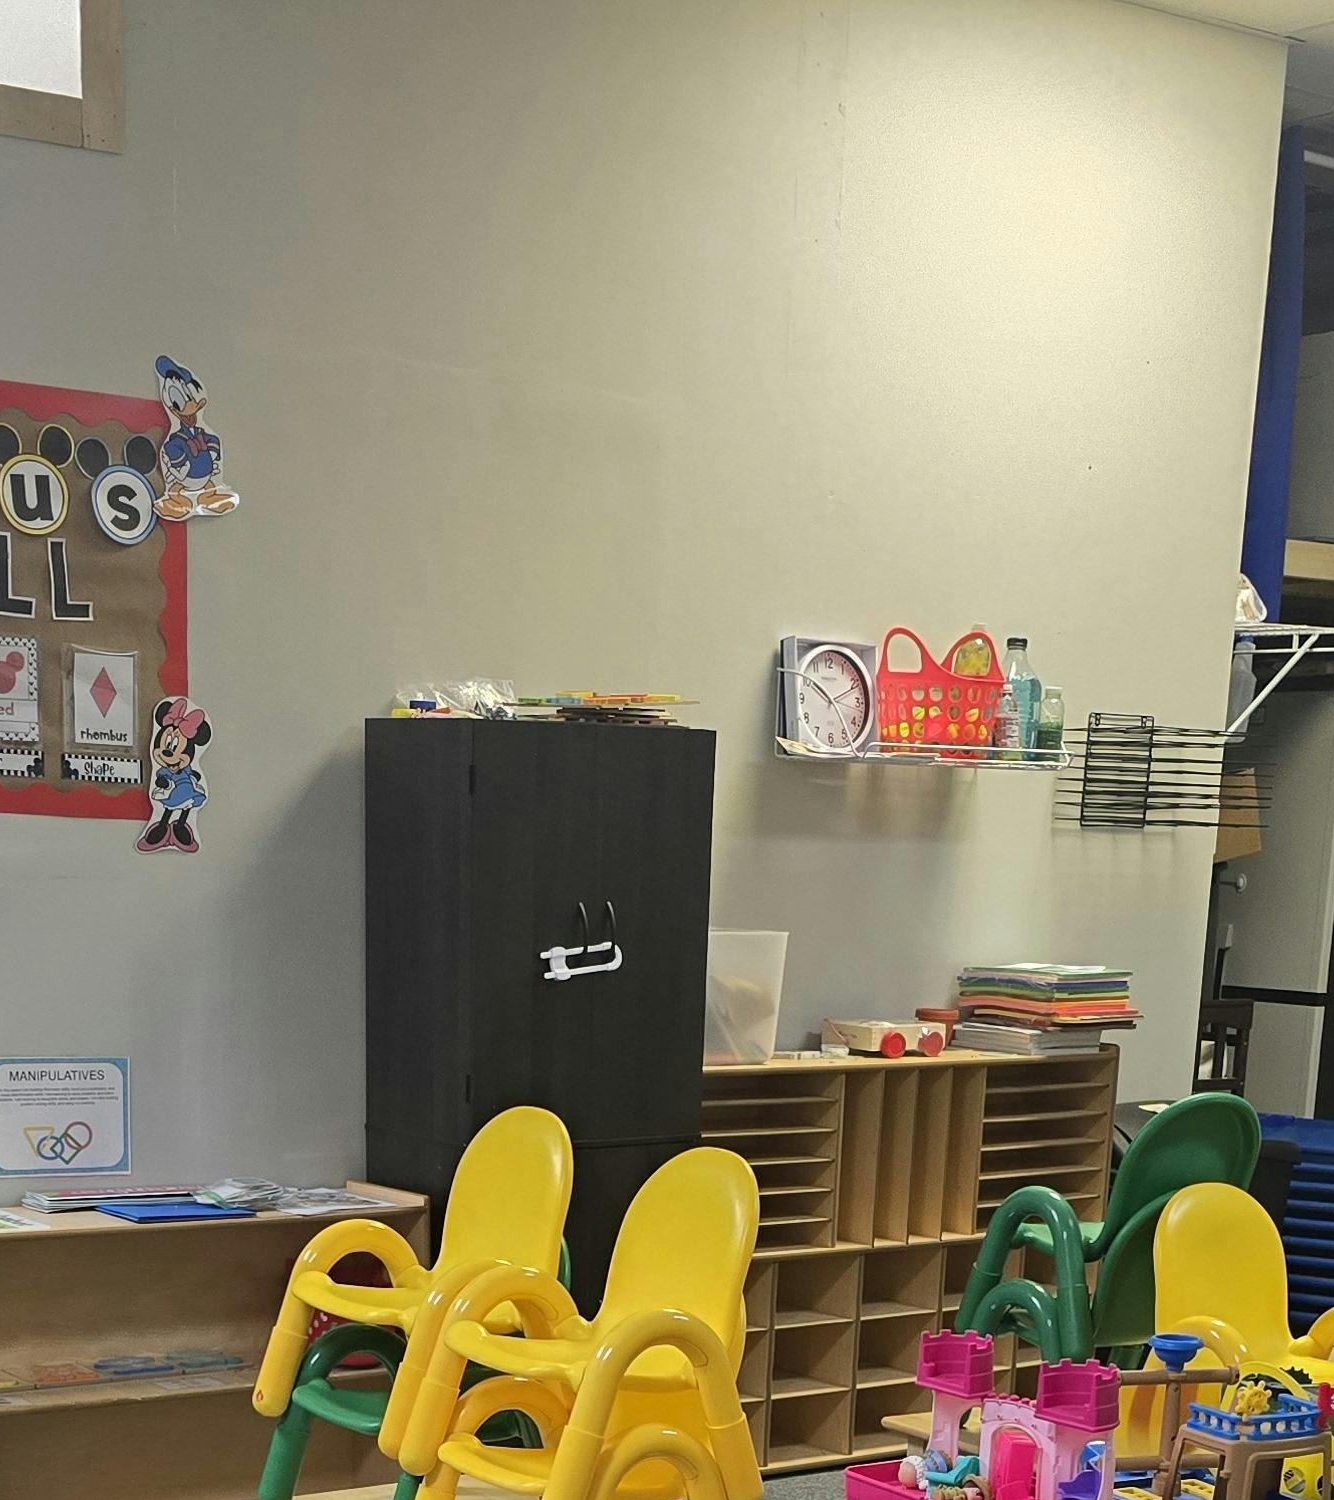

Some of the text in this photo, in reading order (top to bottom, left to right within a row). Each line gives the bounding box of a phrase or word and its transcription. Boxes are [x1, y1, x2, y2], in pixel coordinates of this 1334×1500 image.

[812, 662, 819, 673] 11
[824, 658, 833, 669] 12
[799, 692, 805, 704] 9
[854, 697, 861, 708] 3
[803, 712, 809, 724] 8
[850, 716, 857, 727] 4
[80, 729, 128, 742] rhombus
[814, 726, 820, 737] 7
[841, 728, 847, 740] 5
[828, 732, 834, 744] 6
[9, 1069, 105, 1081] MANIPULATIVES
